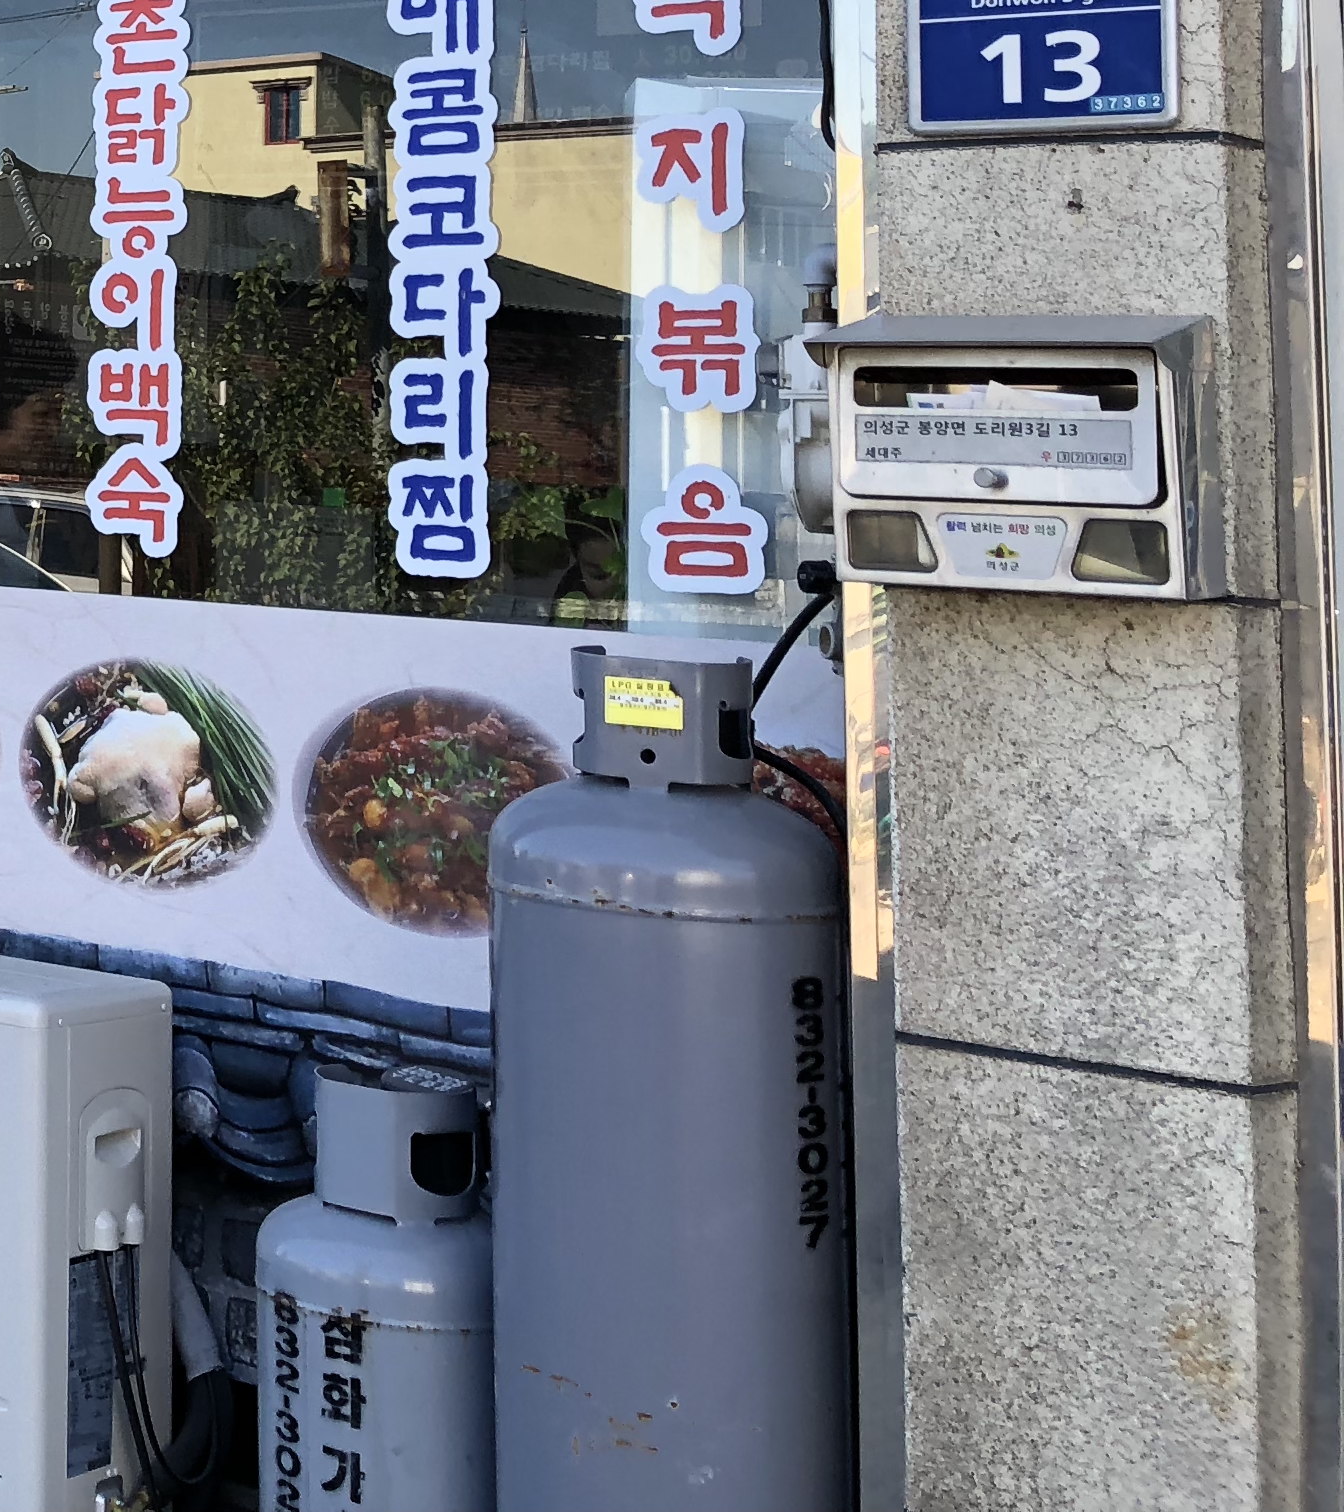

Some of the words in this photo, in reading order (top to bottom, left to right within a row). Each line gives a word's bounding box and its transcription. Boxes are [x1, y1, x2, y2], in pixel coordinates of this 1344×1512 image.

[979, 29, 1102, 104] 13
[1093, 94, 1161, 111] 37362
[863, 419, 910, 436] 의성군
[917, 420, 966, 436] 봉양면
[972, 420, 1051, 438] 도리원3길
[1058, 423, 1079, 437] 13
[864, 446, 903, 459] 세대주
[792, 976, 829, 1250] 832-3027
